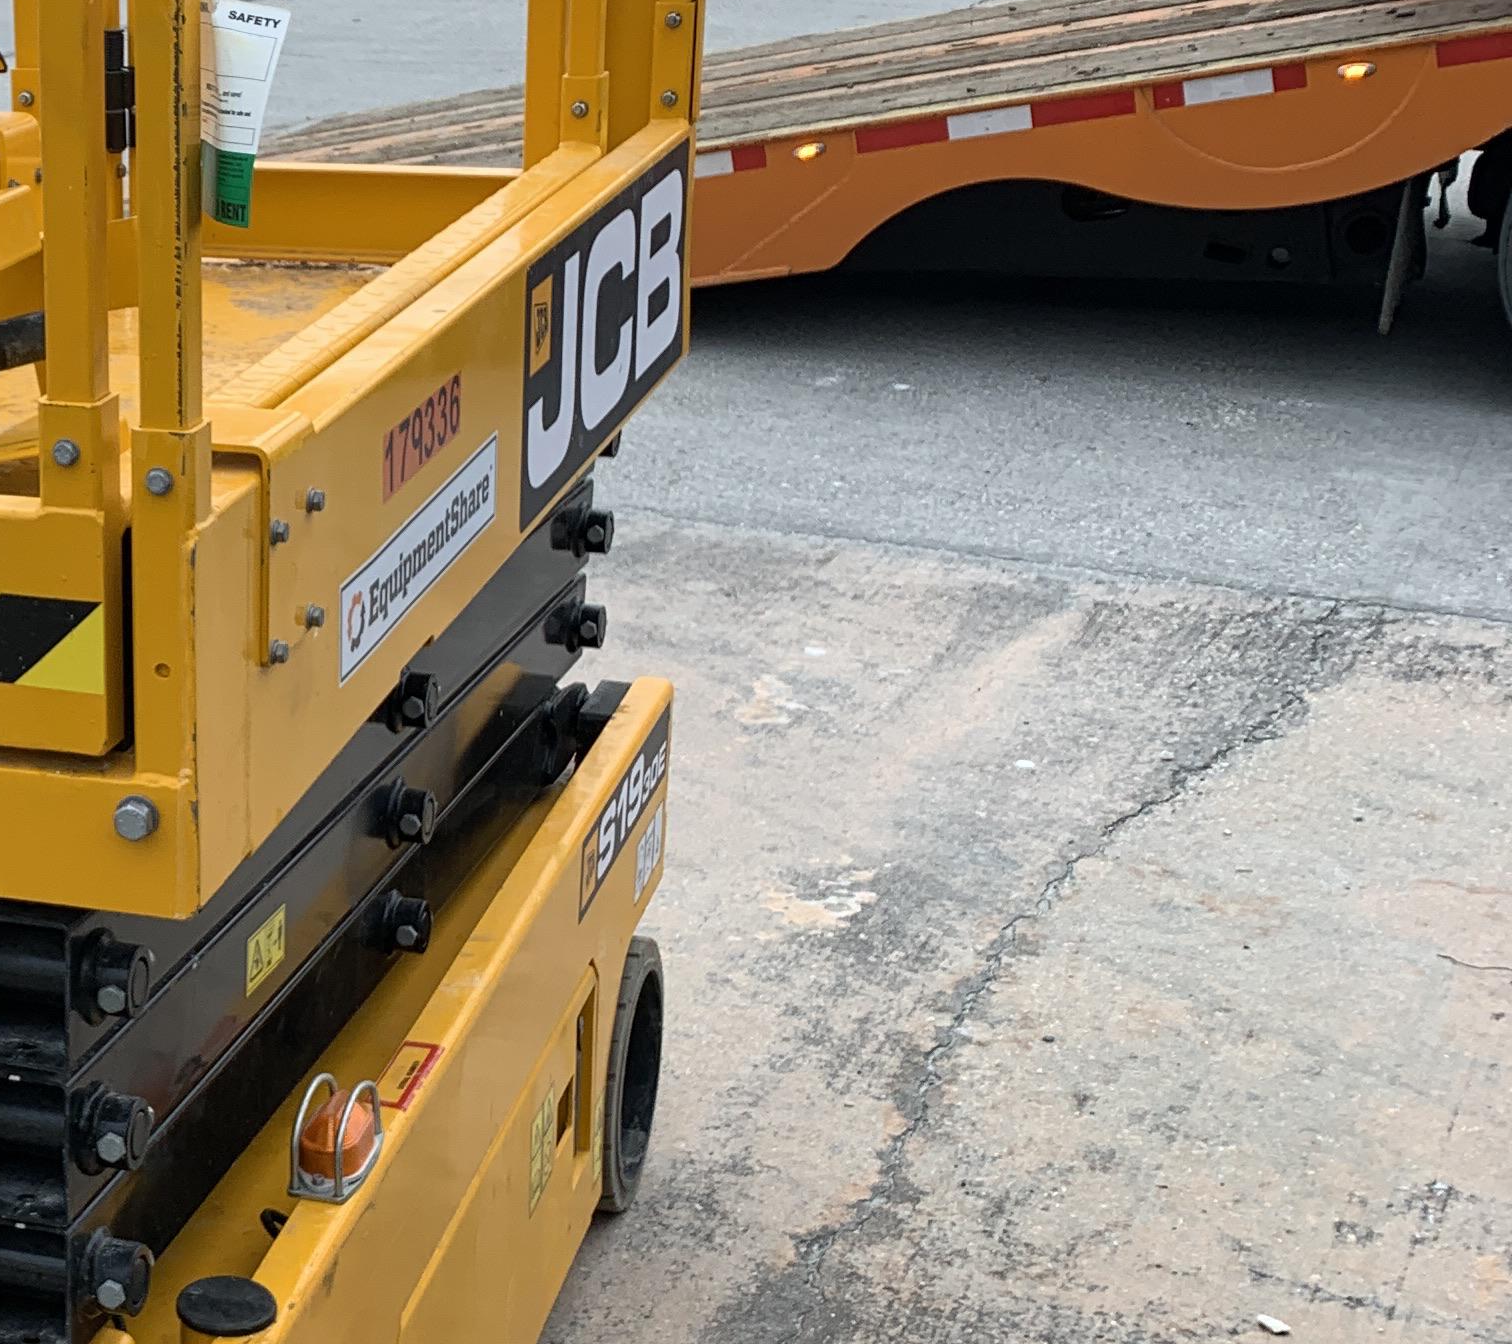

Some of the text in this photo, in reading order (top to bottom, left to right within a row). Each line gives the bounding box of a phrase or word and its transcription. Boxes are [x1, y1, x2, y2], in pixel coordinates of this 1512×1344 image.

[228, 10, 282, 29] SAFETY
[527, 168, 683, 489] JCB
[384, 374, 460, 493] 179336
[368, 471, 491, 627] EquipmentShare
